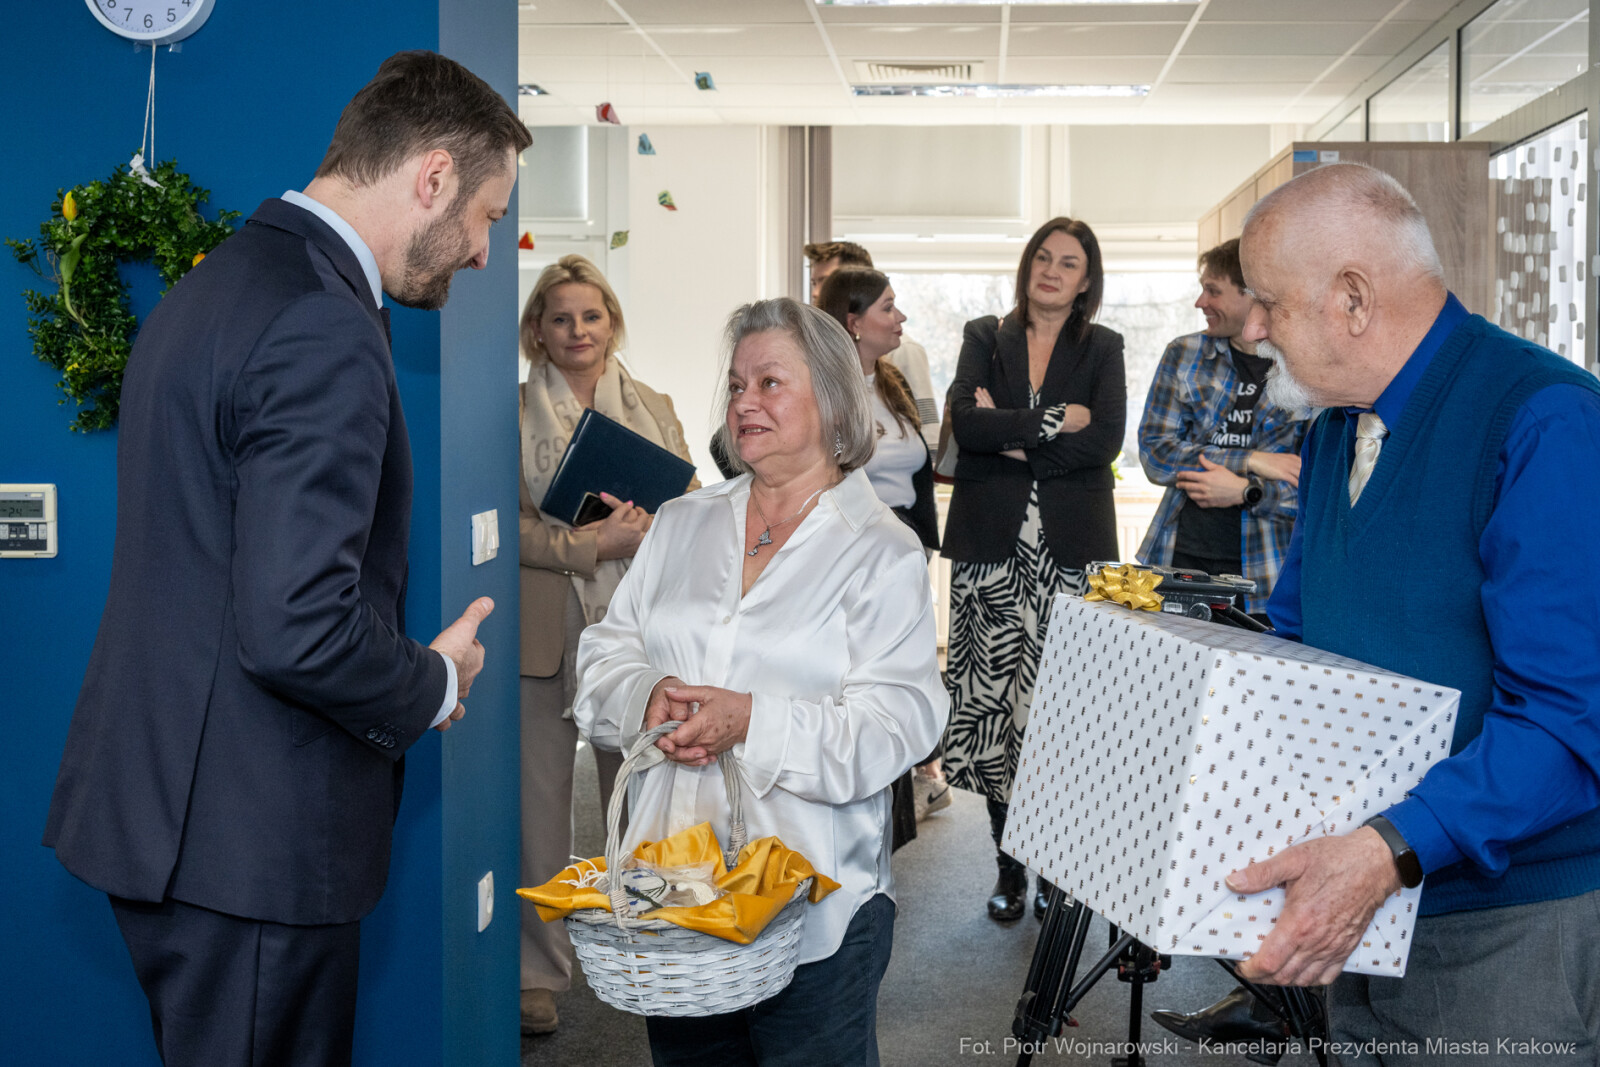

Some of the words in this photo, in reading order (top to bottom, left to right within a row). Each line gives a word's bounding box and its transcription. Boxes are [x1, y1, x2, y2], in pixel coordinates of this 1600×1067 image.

[123, 8, 133, 22] 7
[143, 14, 153, 28] 6
[166, 8, 177, 22] 5
